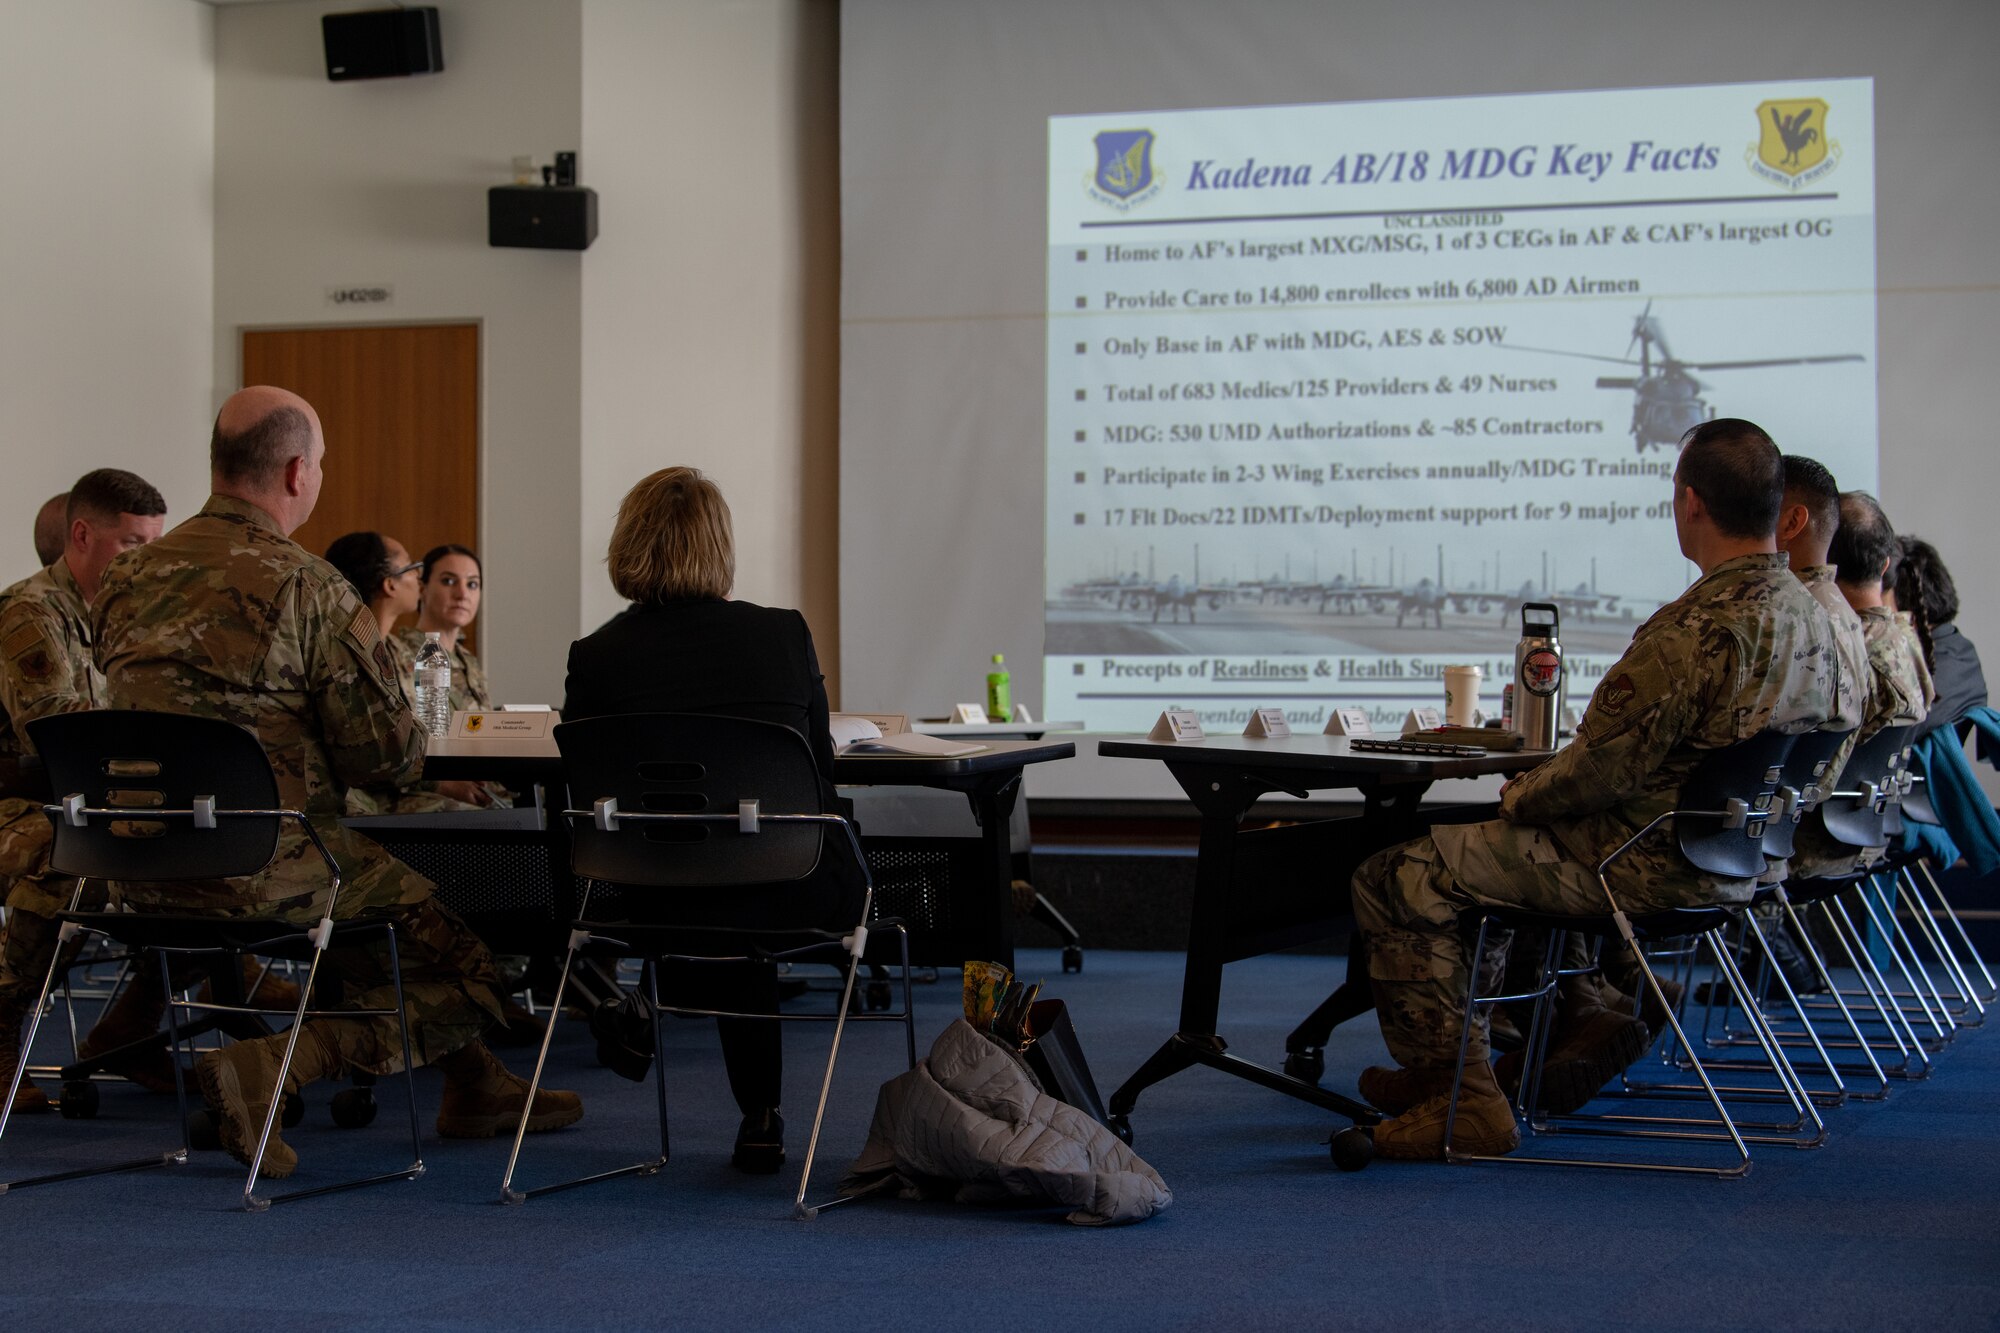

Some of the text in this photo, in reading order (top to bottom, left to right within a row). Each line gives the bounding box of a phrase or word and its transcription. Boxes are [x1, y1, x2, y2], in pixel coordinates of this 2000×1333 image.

[1186, 141, 1721, 191] Kadena AB/18 MDG Key Facts
[1383, 212, 1504, 230] UNCLASSIFIED
[1104, 218, 1833, 262] Home to AF's largest MXG/MSG, 1 of 3 CEGs in AF & CAF's largest OG
[1104, 276, 1641, 309] Provide Care to 14,800 enrollees with 6,800 AD Airmen
[1103, 326, 1507, 359] Only Base in AF with MDG, AES & SOW
[1103, 374, 1558, 402] Total of 683 Medics/125 Providers & 49 Nurses
[1103, 417, 1604, 443] MDG: 530 UMD Authorizations & ~85 Contractors
[1103, 457, 1671, 489] Participate in 2-3 Wing Exercises annually/MDG Training
[1104, 508, 1125, 526] 17
[1130, 509, 1157, 525] Flt
[1162, 507, 1236, 525] Docs/22
[1241, 505, 1436, 528] IDMTs/Deployment
[1440, 505, 1519, 526] support
[1524, 502, 1555, 520] for
[1558, 502, 1573, 519] 9
[1577, 501, 1641, 524] major
[1102, 660, 1182, 682] Precepts
[1187, 660, 1209, 677] of
[1212, 660, 1309, 681] Readiness
[1314, 660, 1332, 677] &
[1338, 659, 1402, 681] Health
